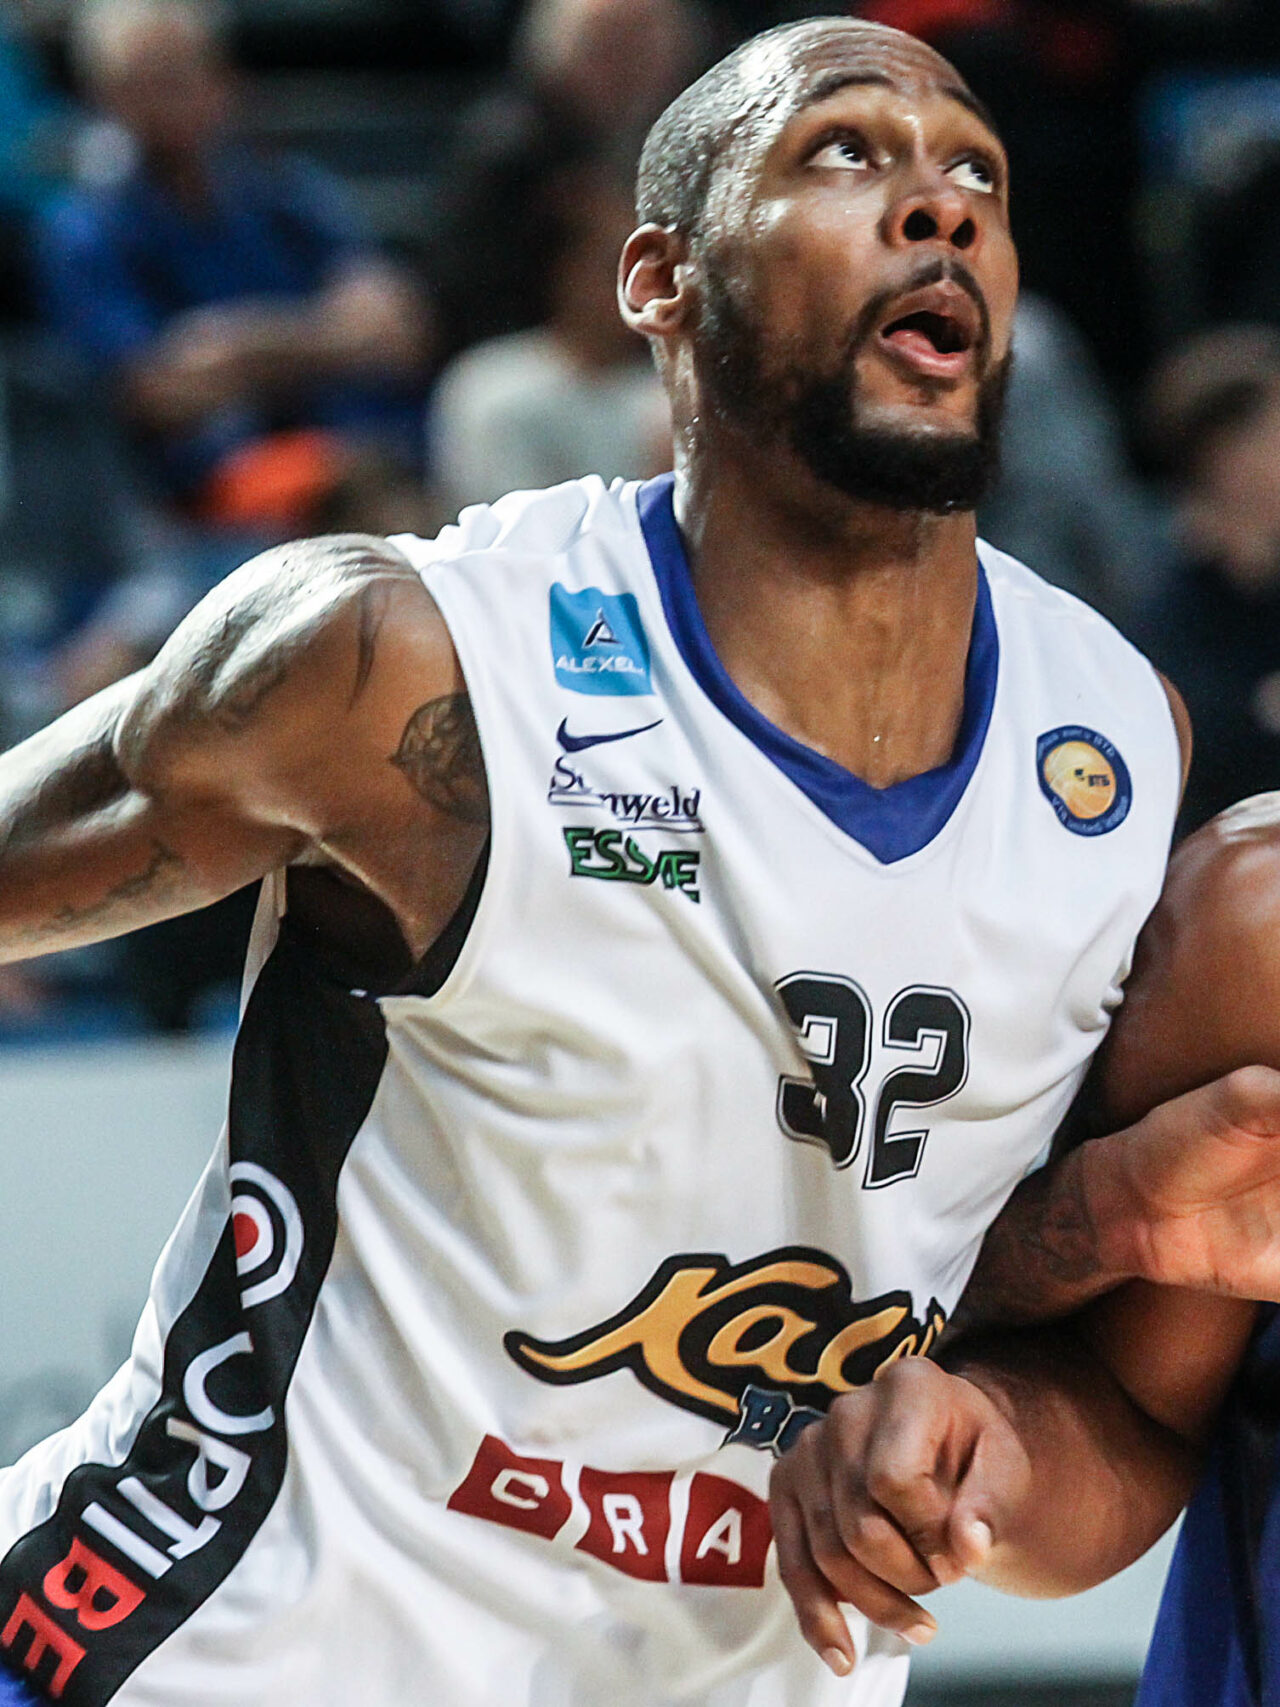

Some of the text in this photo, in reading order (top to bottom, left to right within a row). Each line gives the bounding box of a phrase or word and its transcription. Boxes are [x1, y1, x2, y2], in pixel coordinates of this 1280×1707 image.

[555, 654, 645, 675] ALEXEL
[550, 756, 701, 822] Snweld
[773, 970, 972, 1190] 32
